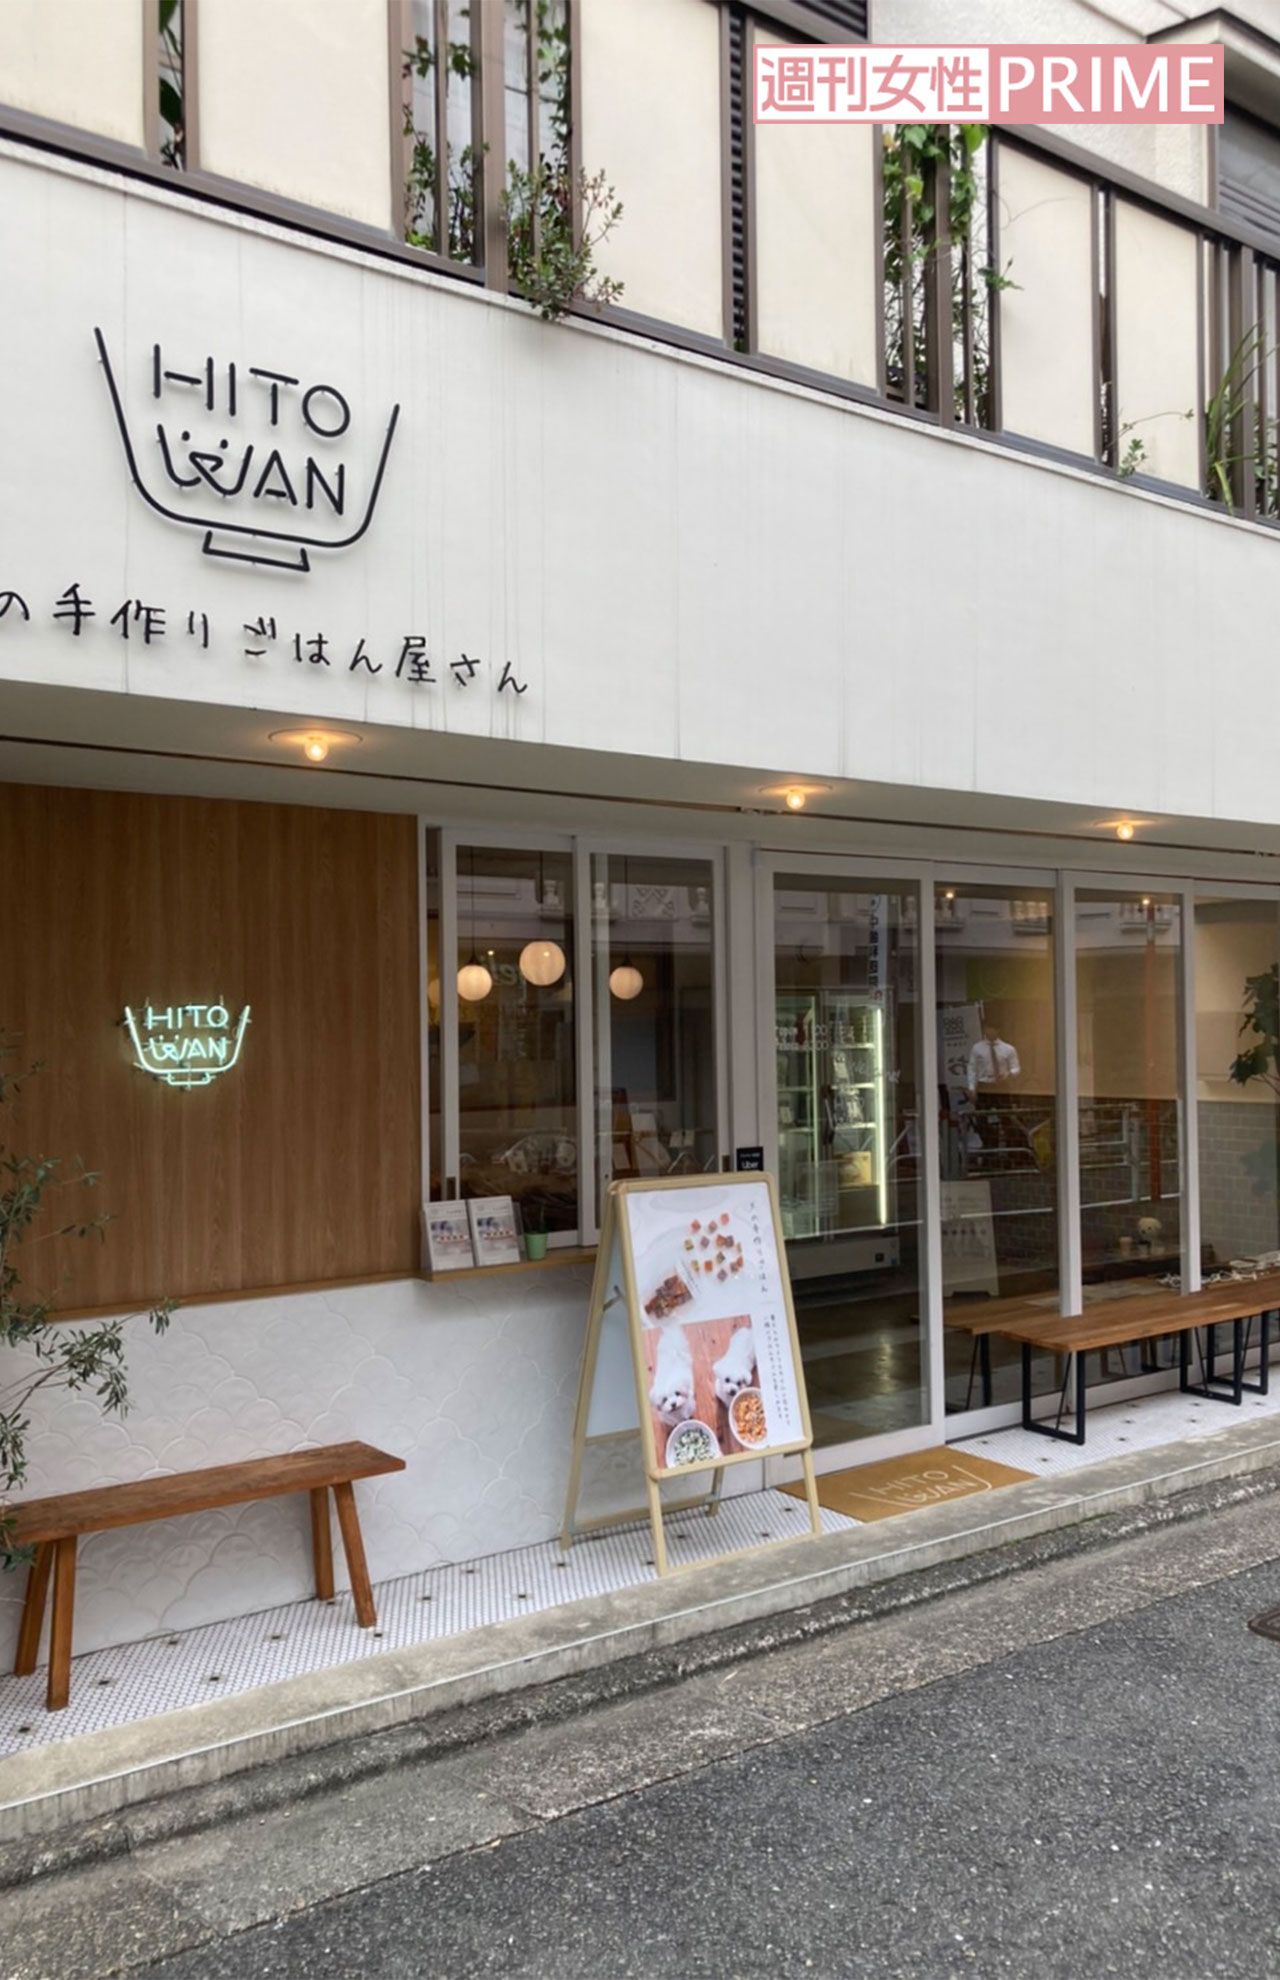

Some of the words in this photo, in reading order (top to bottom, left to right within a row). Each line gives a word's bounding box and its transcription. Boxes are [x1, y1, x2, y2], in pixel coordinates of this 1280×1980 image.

[153, 343, 351, 437] HITO
[156, 423, 345, 515] WAN
[147, 1005, 229, 1030] HITO
[149, 1034, 227, 1061] WAN
[868, 1470, 949, 1495] HITO
